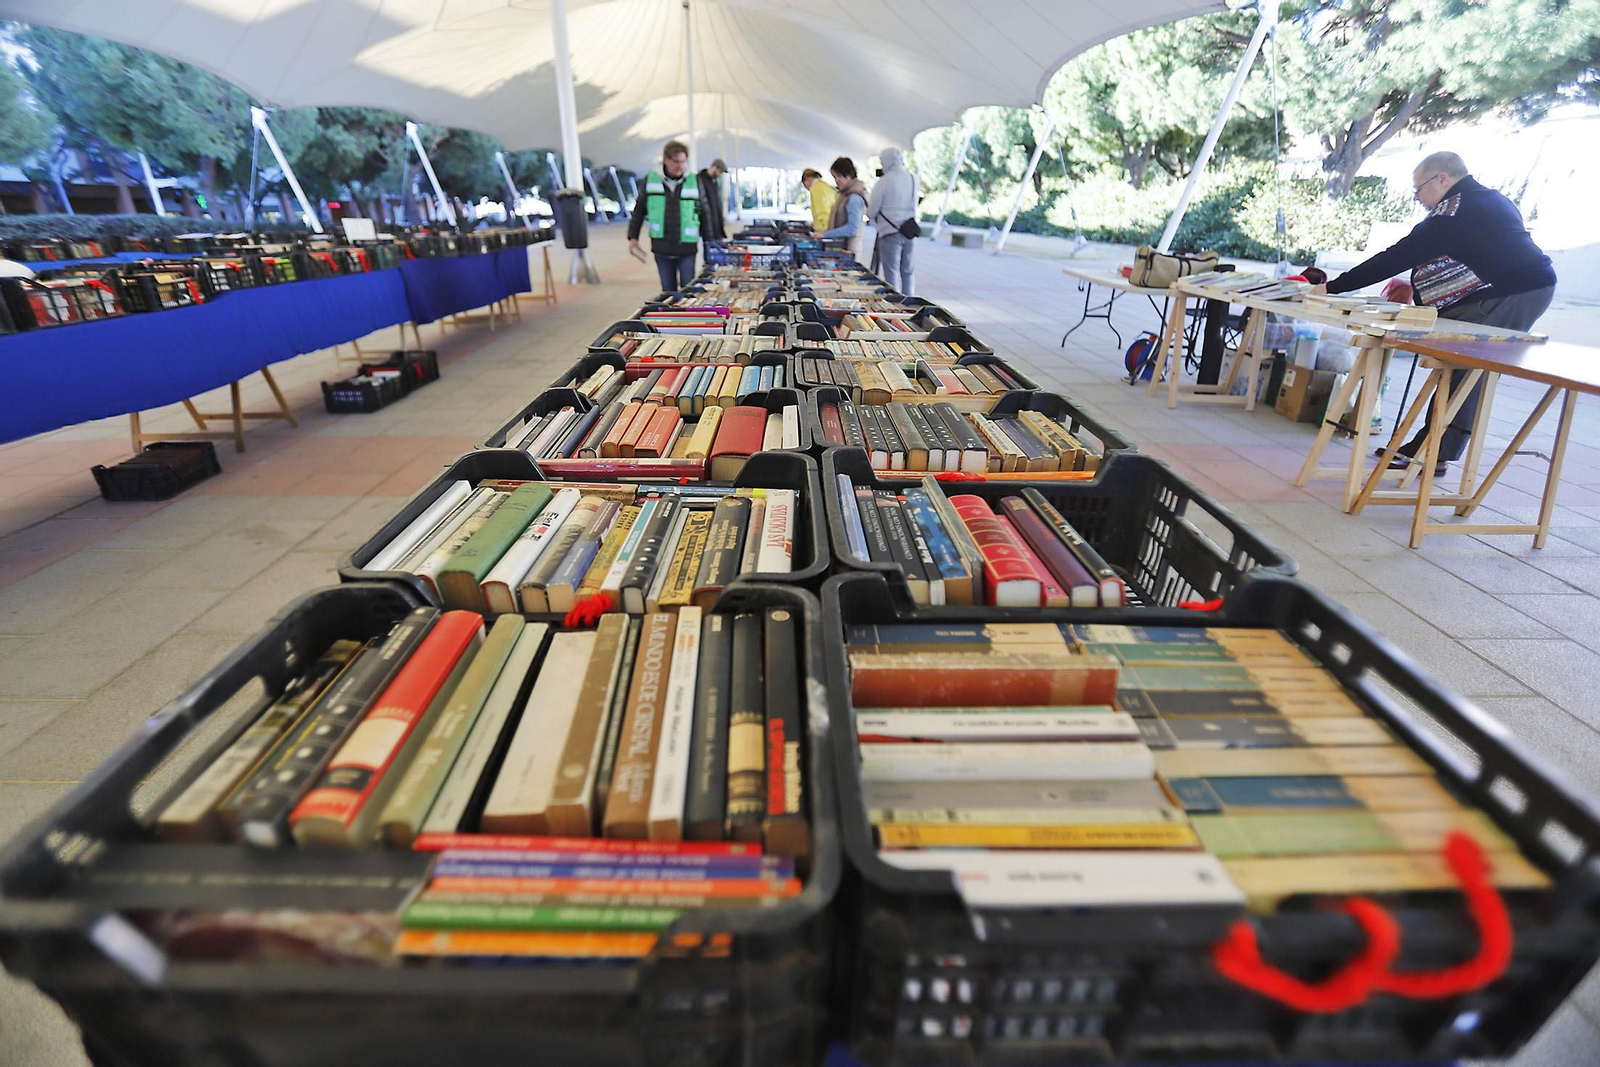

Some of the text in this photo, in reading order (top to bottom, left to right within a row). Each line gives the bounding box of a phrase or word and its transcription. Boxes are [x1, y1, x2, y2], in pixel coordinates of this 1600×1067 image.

[766, 534, 785, 547] LAS
[628, 612, 669, 756] EL MUNDO ES DE CRISTAL
